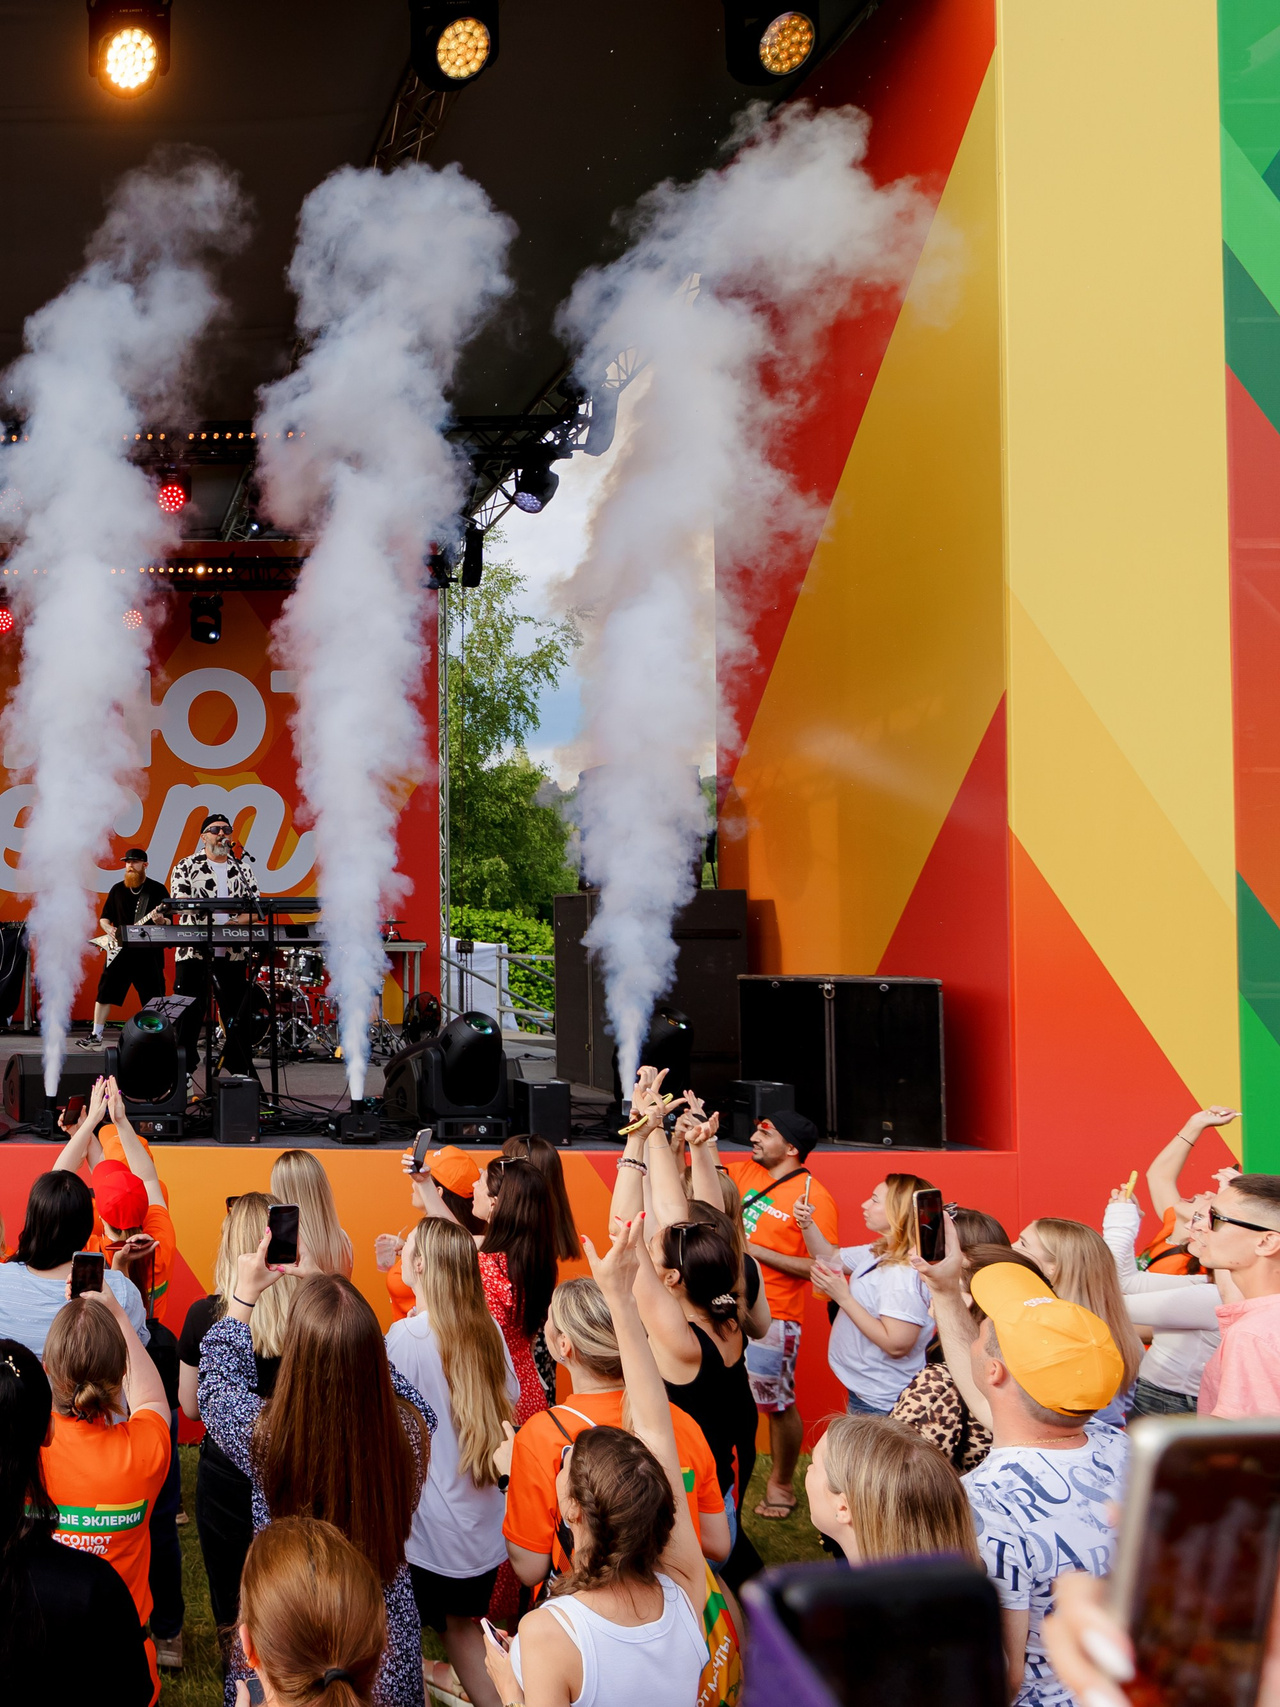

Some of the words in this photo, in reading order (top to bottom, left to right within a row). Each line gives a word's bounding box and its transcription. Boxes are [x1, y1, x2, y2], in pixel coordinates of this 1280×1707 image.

[222, 928, 265, 938] Roland
[82, 1511, 141, 1527] ЭКЛЕРКИ
[52, 1532, 112, 1546] БСОЛЮТ
